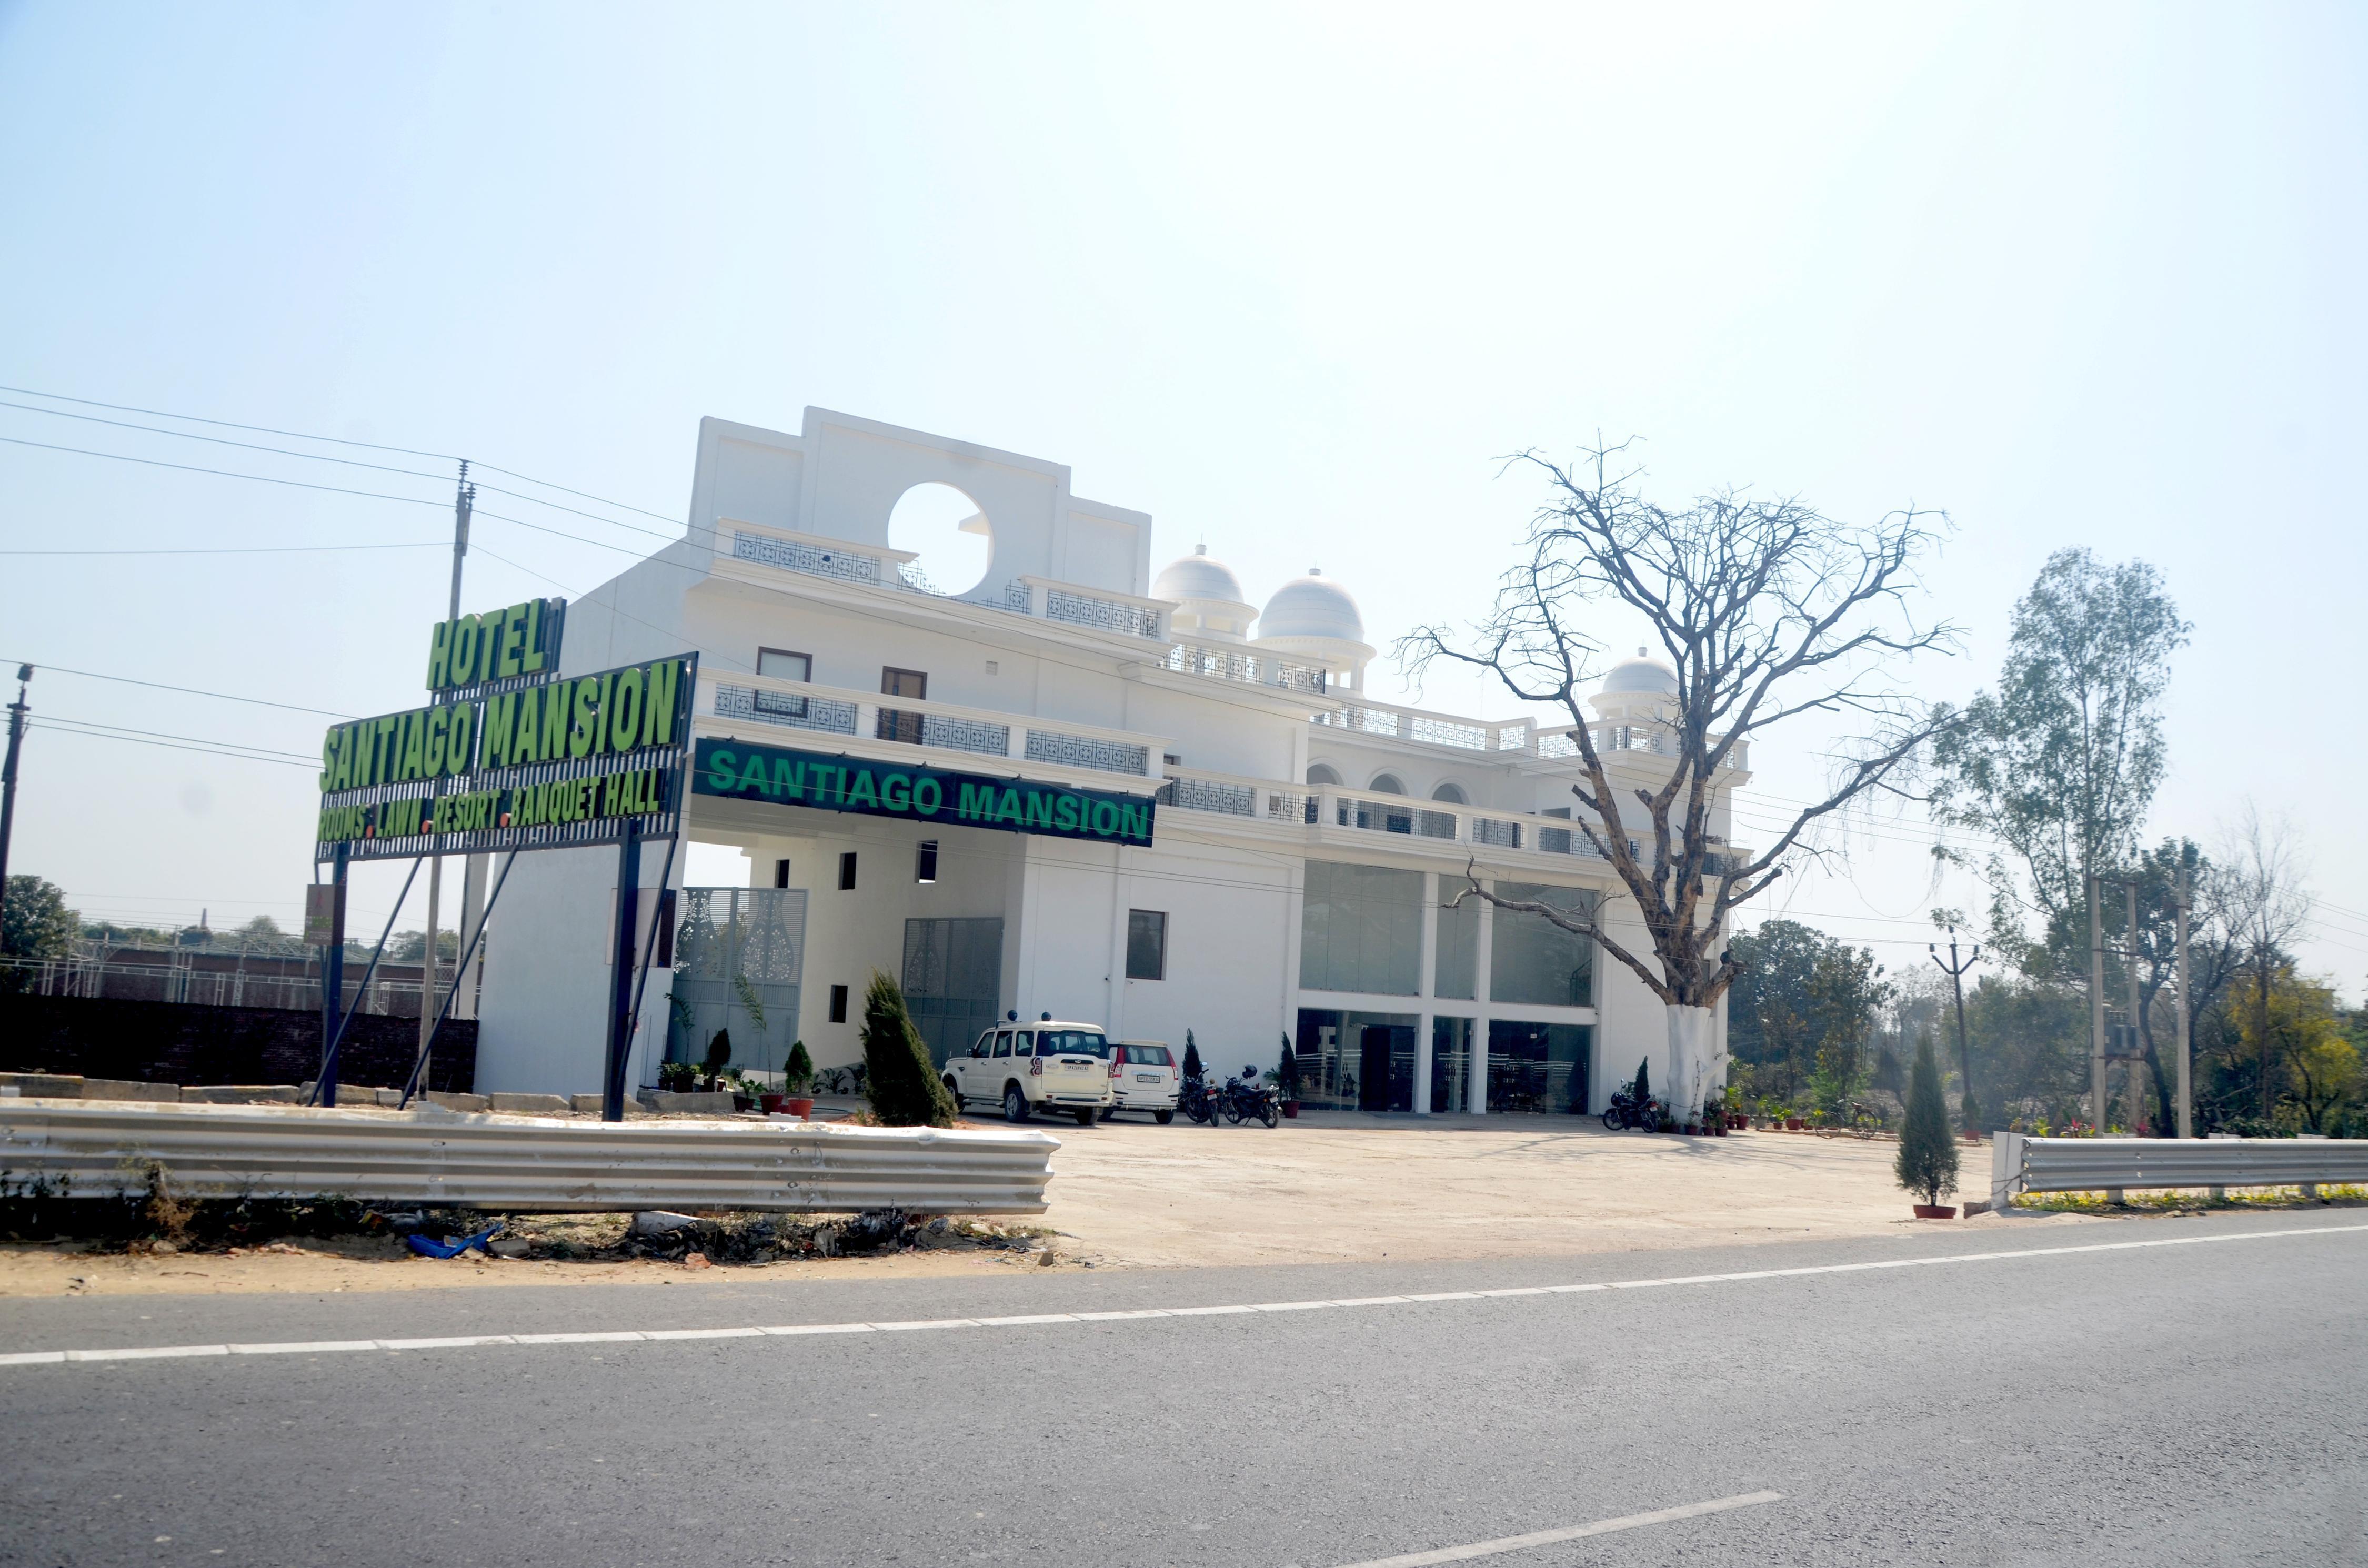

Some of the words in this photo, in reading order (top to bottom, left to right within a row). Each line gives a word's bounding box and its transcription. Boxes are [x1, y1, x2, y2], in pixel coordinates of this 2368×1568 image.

[426, 598, 544, 690] HOTEL
[319, 701, 473, 792] SANTIAGO
[481, 660, 680, 769] MANSION
[317, 803, 365, 841] ROOMS
[376, 798, 421, 837] LAWN
[432, 789, 500, 834] RESORT
[510, 776, 600, 826] BANQUET
[604, 767, 659, 816] HALL
[708, 750, 942, 815] SANTIAGO
[959, 783, 1148, 839] MANSION
